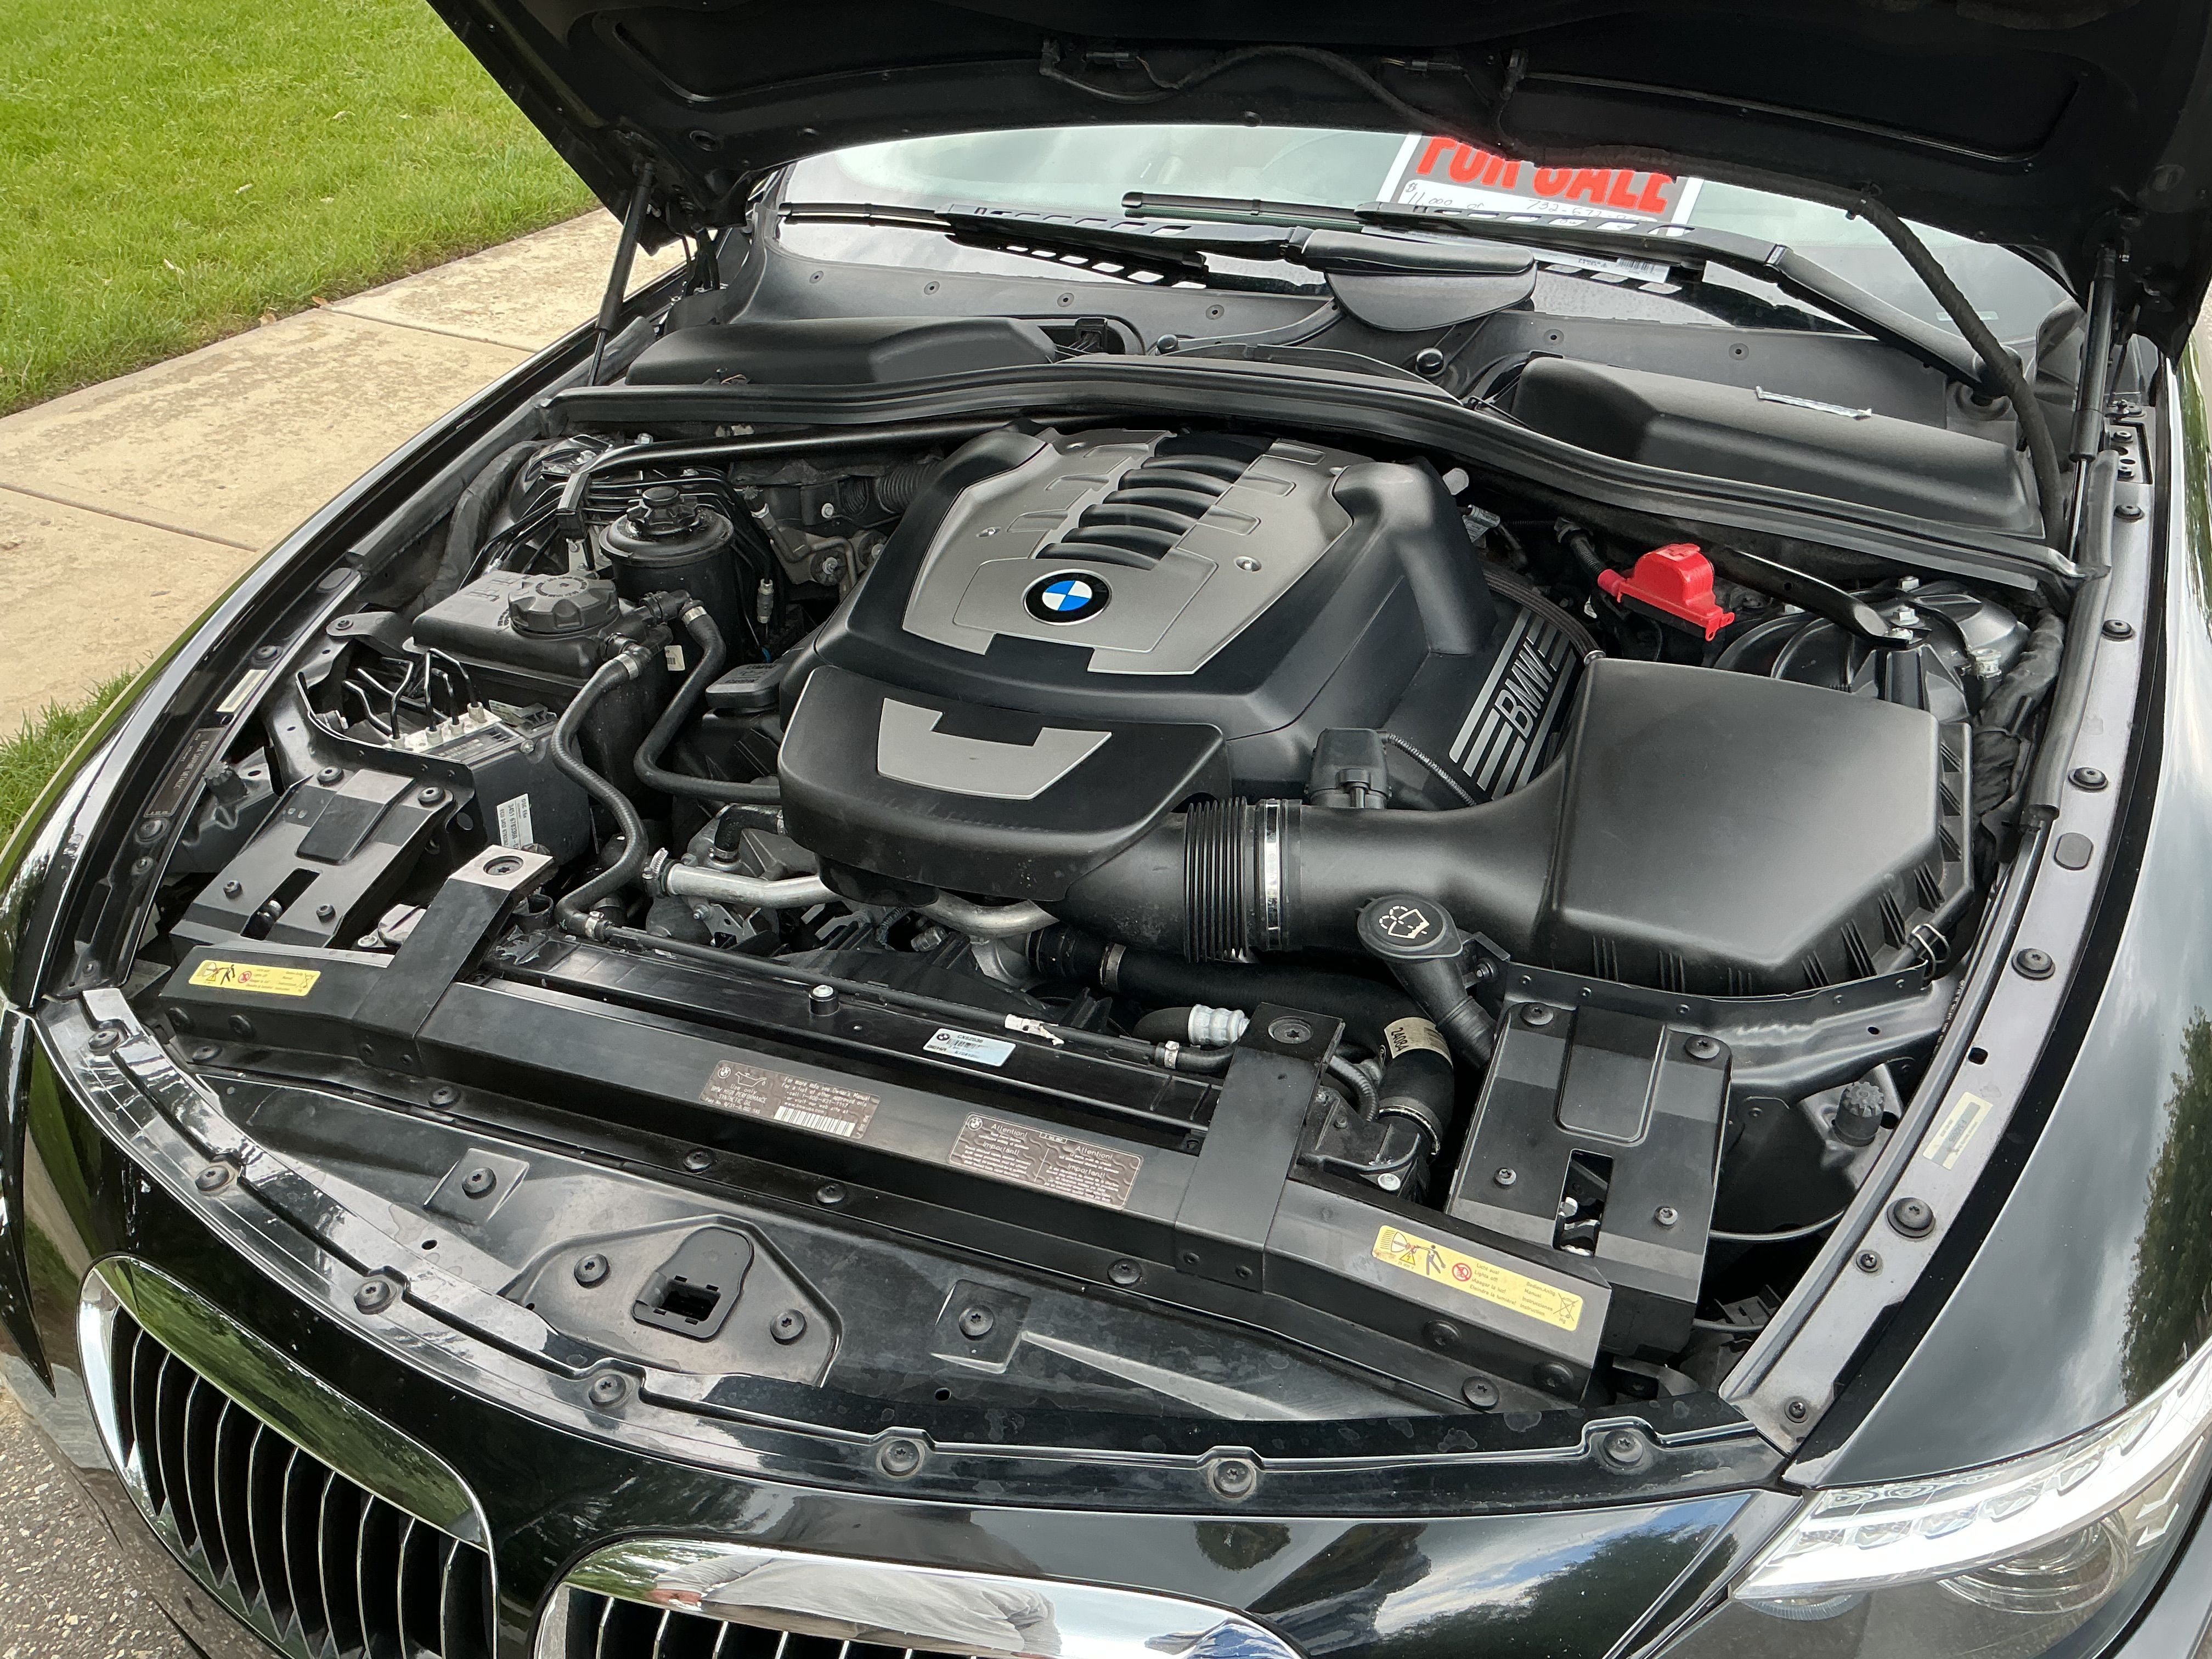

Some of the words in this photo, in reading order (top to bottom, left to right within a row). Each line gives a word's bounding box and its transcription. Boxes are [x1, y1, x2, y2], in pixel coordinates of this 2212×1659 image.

[1494, 640, 1553, 740] BMW
[991, 1123, 1028, 1138] Attention!
[983, 1141, 1020, 1156] Important!
[1074, 1145, 1113, 1160] Attention!
[1068, 1163, 1105, 1178] Important!
[1474, 1270, 1489, 1279] Lights
[1476, 1263, 1488, 1271] Licht
[1524, 1288, 1542, 1299] Manual
[1520, 1303, 1545, 1316] Instruction
[1522, 1296, 1554, 1312] Instrucciones
